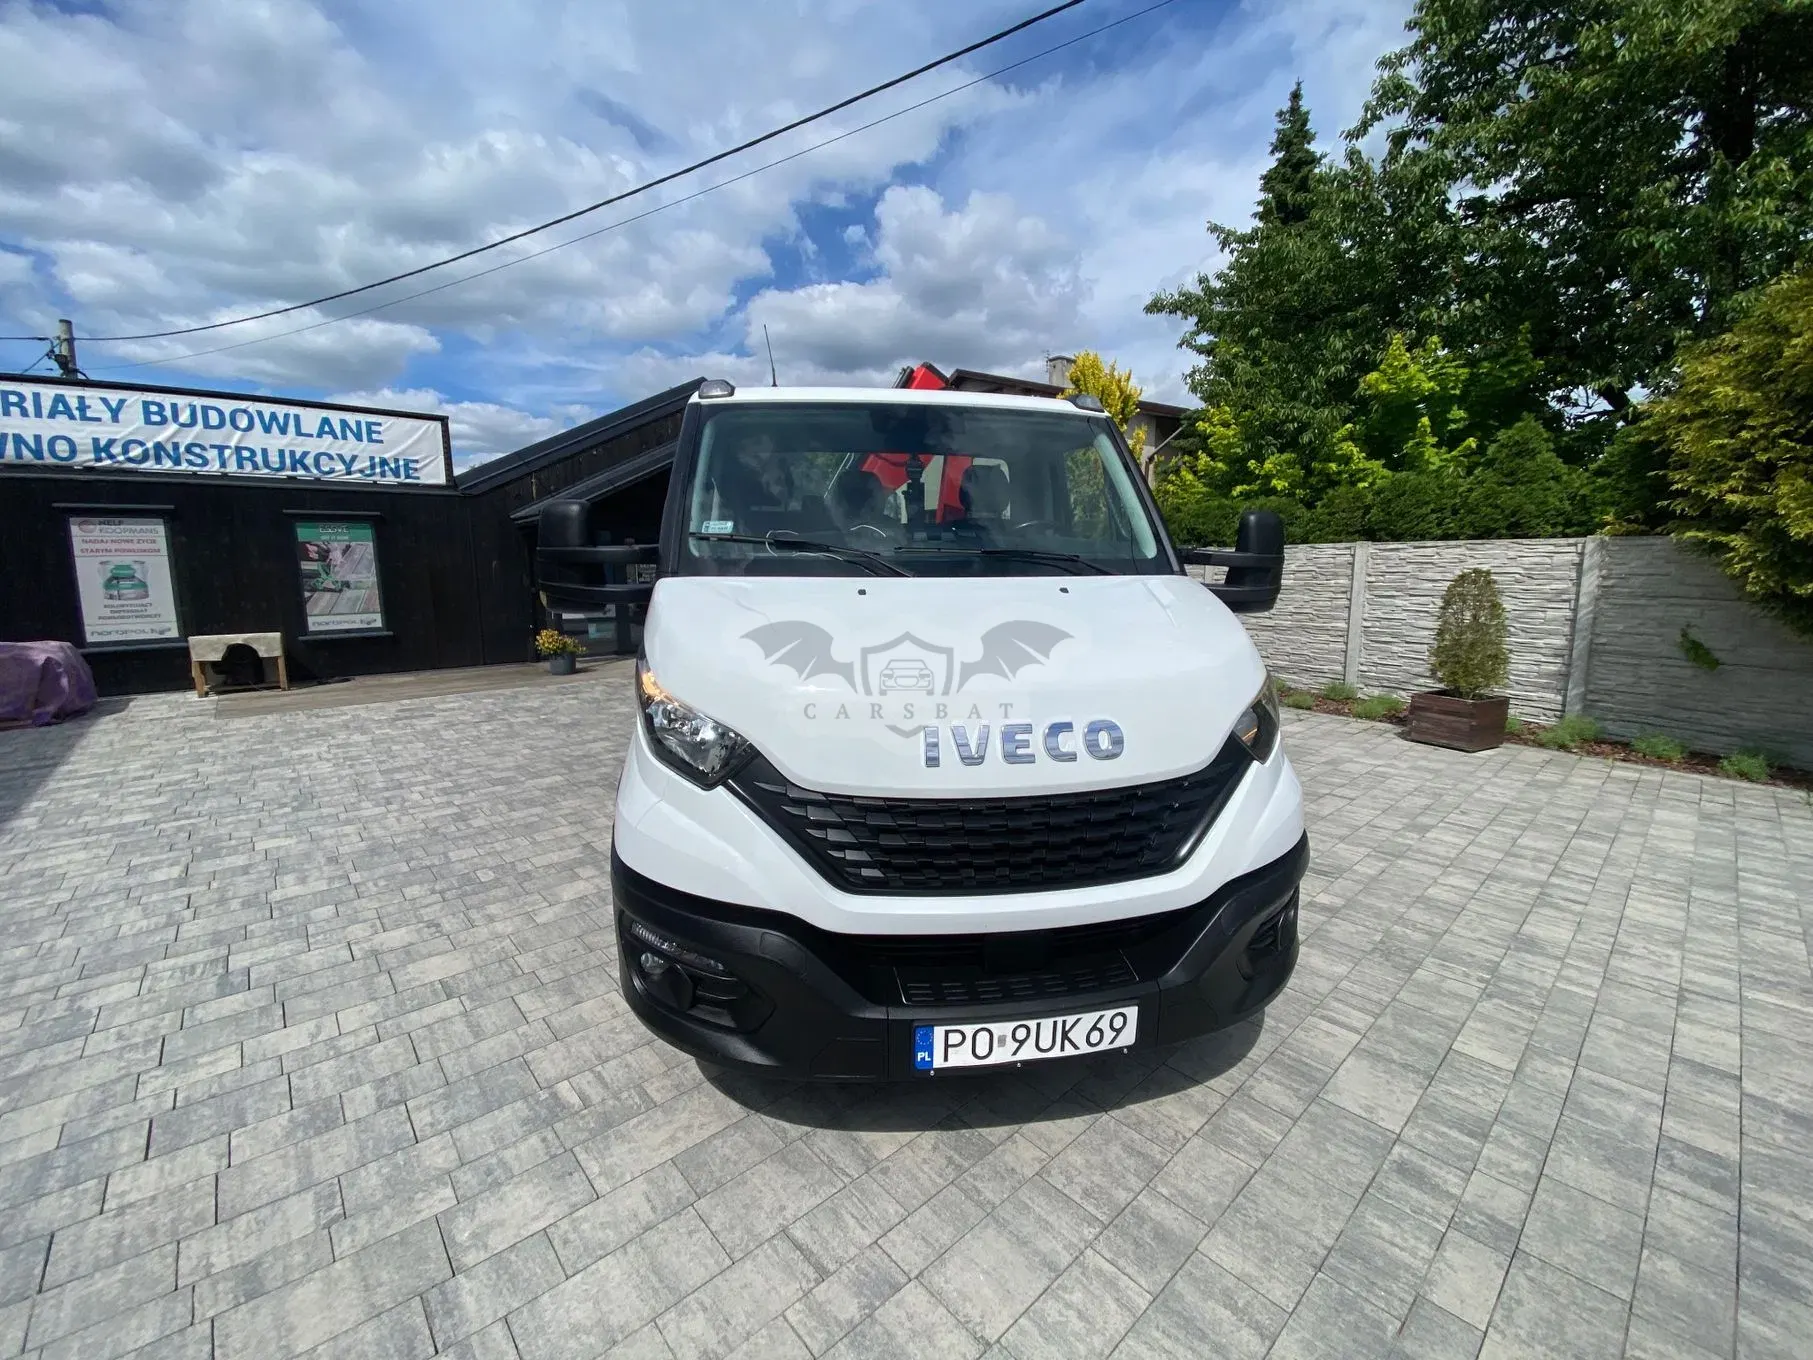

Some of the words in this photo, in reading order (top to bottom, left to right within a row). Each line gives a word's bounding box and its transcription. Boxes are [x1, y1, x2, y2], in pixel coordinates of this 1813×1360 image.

[141, 399, 384, 444] BUDOWLANE
[91, 436, 421, 480] KONSTRUKCYJNE
[921, 718, 1125, 768] IVECO
[917, 1052, 932, 1062] PL
